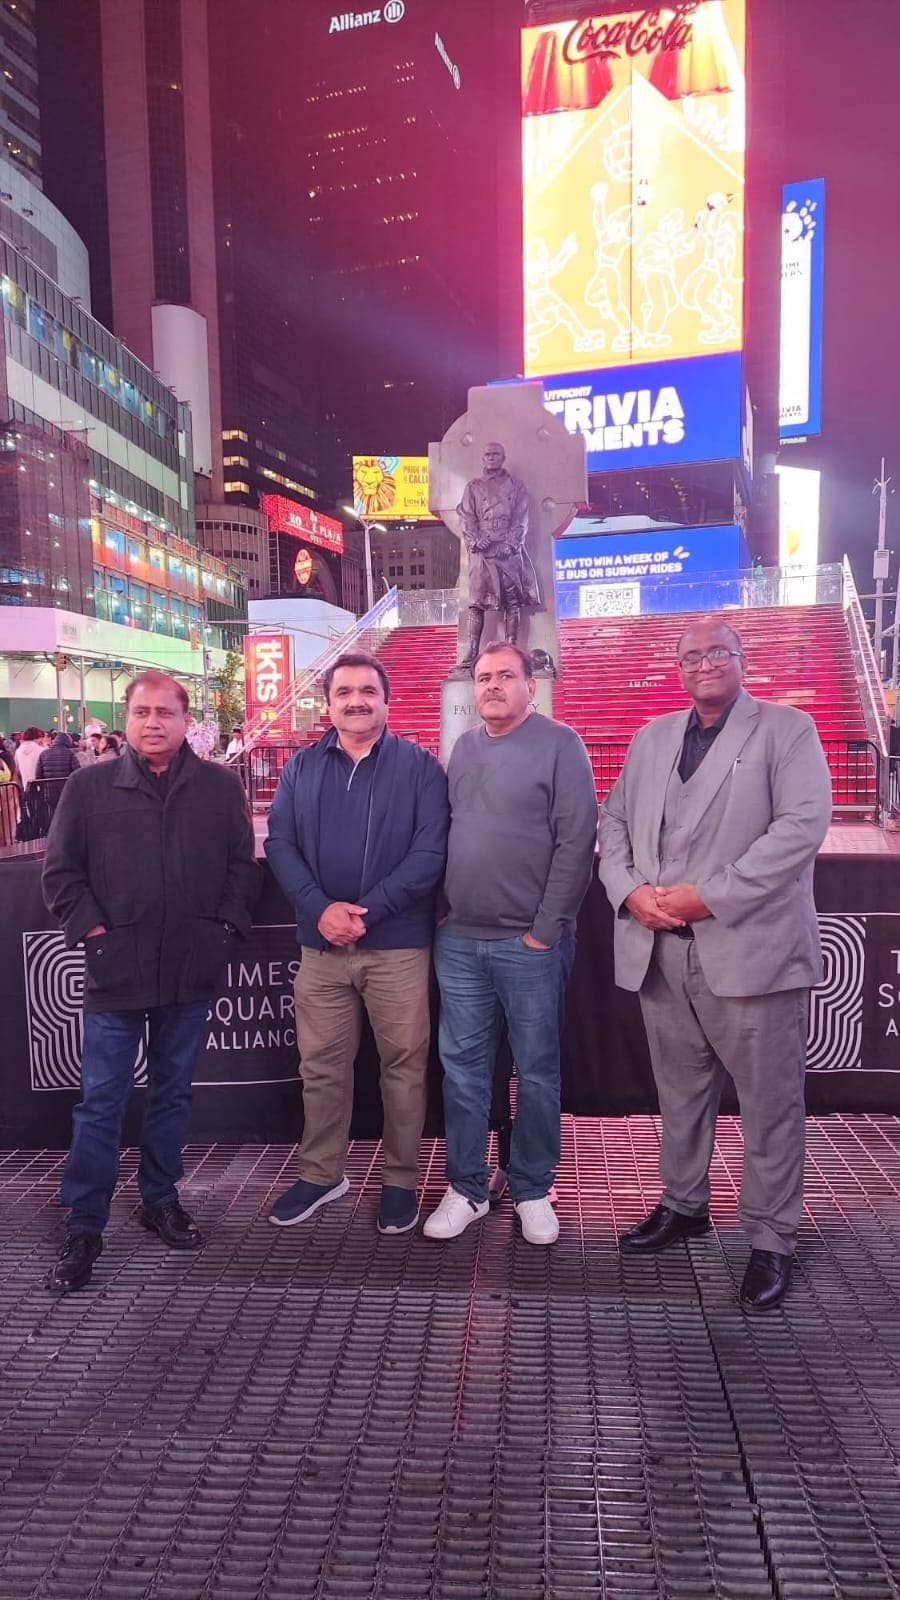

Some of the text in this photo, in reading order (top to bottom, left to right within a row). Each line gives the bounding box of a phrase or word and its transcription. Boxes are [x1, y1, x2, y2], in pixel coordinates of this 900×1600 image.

[329, 9, 381, 34] Allianz
[544, 386, 592, 401] UTFRONT
[581, 418, 685, 452] MENTS
[567, 569, 588, 580] BUS
[589, 567, 604, 578] OR
[605, 564, 649, 577] SUBWAY
[650, 562, 683, 574] RIDES
[578, 557, 592, 568] TO
[593, 556, 613, 566] WIN
[614, 555, 623, 565] A
[623, 553, 652, 564] WEEK
[653, 551, 669, 562] OF
[255, 640, 284, 702] tkts
[227, 961, 300, 987] IMES
[206, 995, 295, 1025] QUAR
[206, 1028, 296, 1050] ALLIANC
